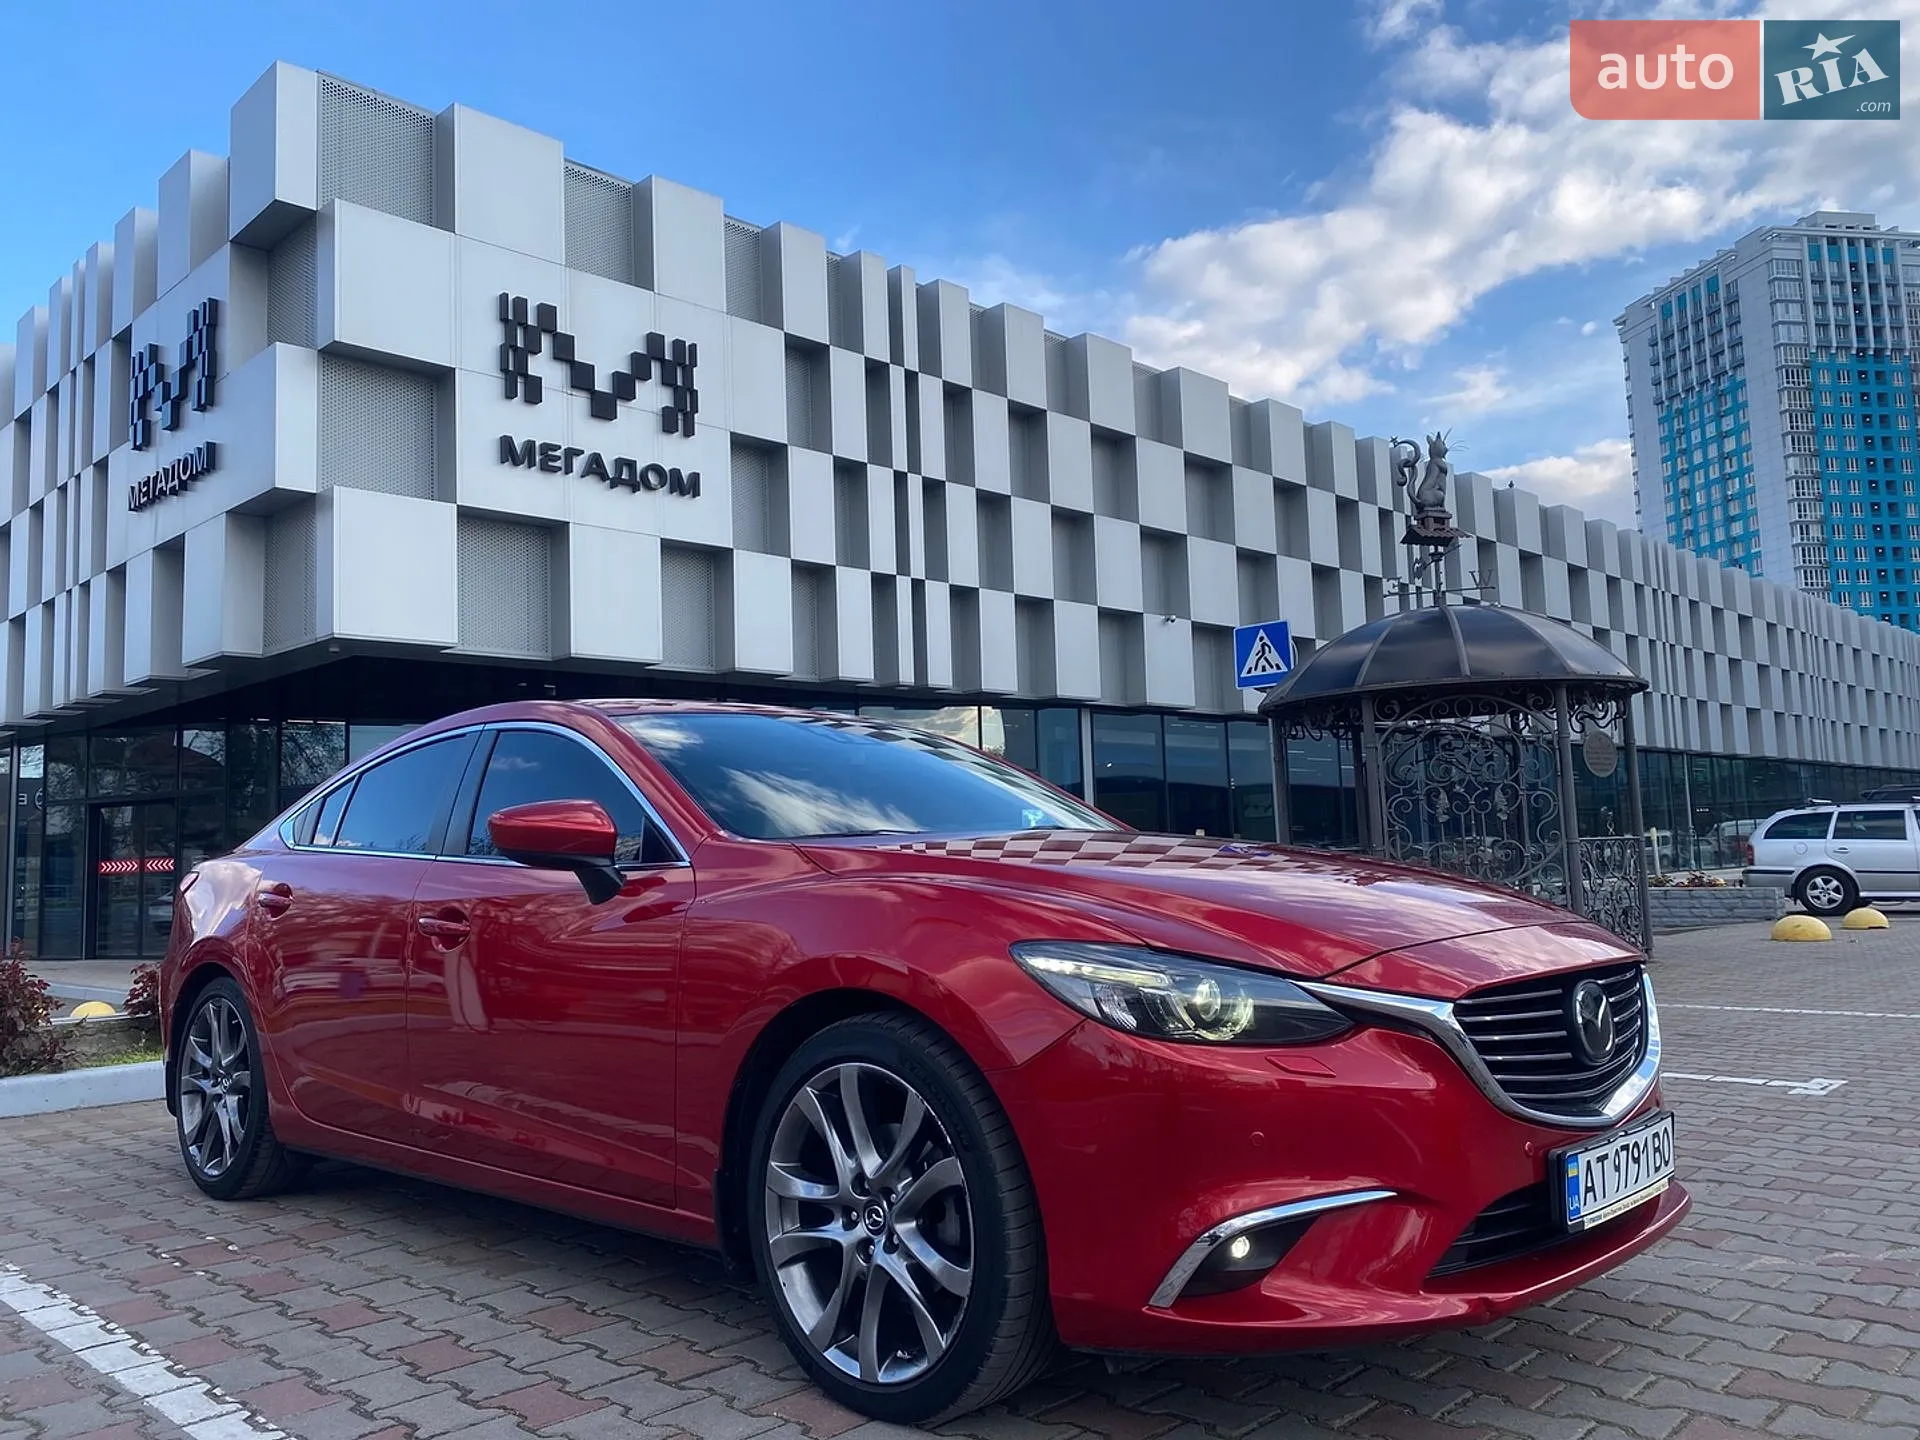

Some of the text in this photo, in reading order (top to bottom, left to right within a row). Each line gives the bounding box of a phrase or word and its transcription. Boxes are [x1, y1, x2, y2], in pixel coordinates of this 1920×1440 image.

[128, 441, 216, 512] МЕГАДОМ
[499, 435, 700, 498] МЕГАДОМ
[1613, 1136, 1650, 1194] 9791
